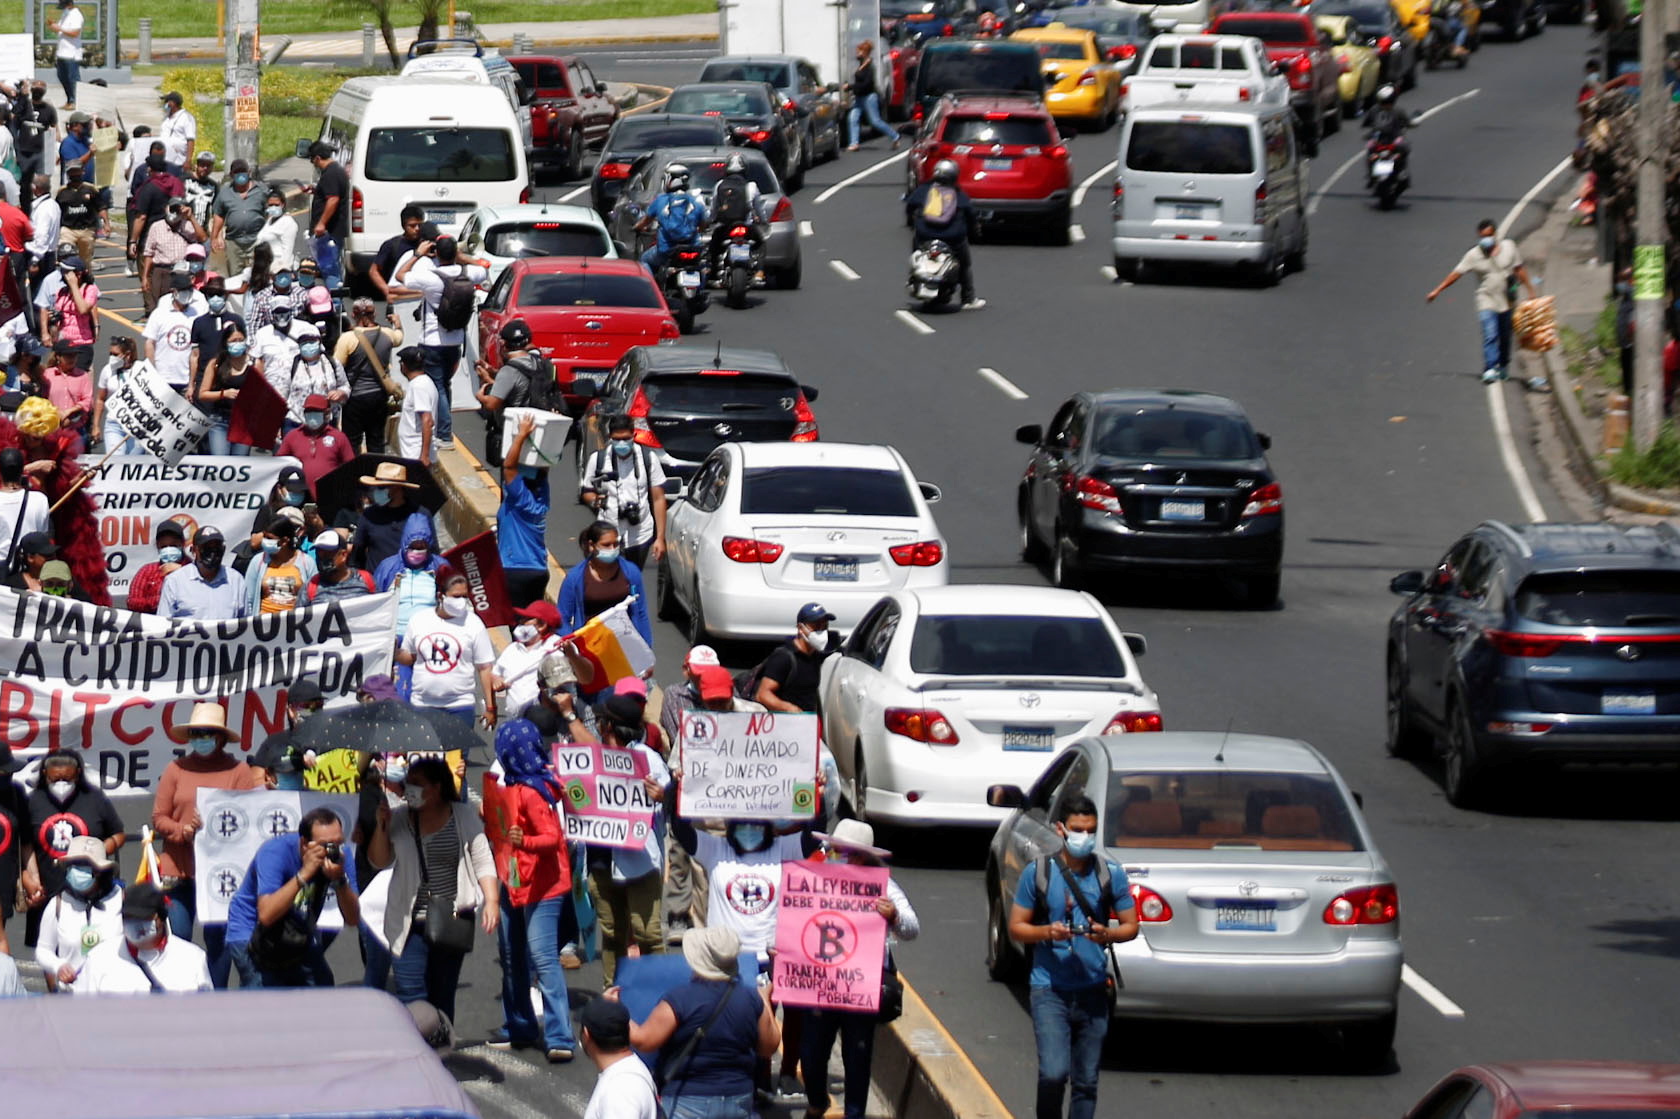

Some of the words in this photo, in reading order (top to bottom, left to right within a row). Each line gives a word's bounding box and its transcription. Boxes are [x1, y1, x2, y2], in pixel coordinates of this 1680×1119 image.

[134, 366, 165, 410] Estamos
[161, 407, 185, 430] ante
[120, 463, 252, 483] MAESTROS
[93, 492, 266, 511] CRIPTOMONED
[461, 551, 490, 612] SIMEDUCO
[62, 638, 365, 698] CRIPTOMONEDA
[745, 712, 775, 737] NO
[98, 748, 150, 791] DE
[561, 752, 590, 770] YO
[603, 753, 633, 770] DIGO
[691, 760, 709, 778] DE
[724, 761, 778, 779] DINERO
[317, 763, 342, 787] AL
[599, 782, 628, 807] NO
[630, 784, 653, 808] AL
[567, 816, 627, 841] BITCOIN
[787, 873, 810, 893] LA
[812, 876, 840, 895] LEY
[840, 878, 883, 897] BITCOIN
[782, 895, 814, 908] DEBE
[784, 961, 828, 980] TRAERA
[835, 967, 865, 982] MAS
[844, 981, 853, 993] Y
[817, 991, 874, 1009] POBREZA
